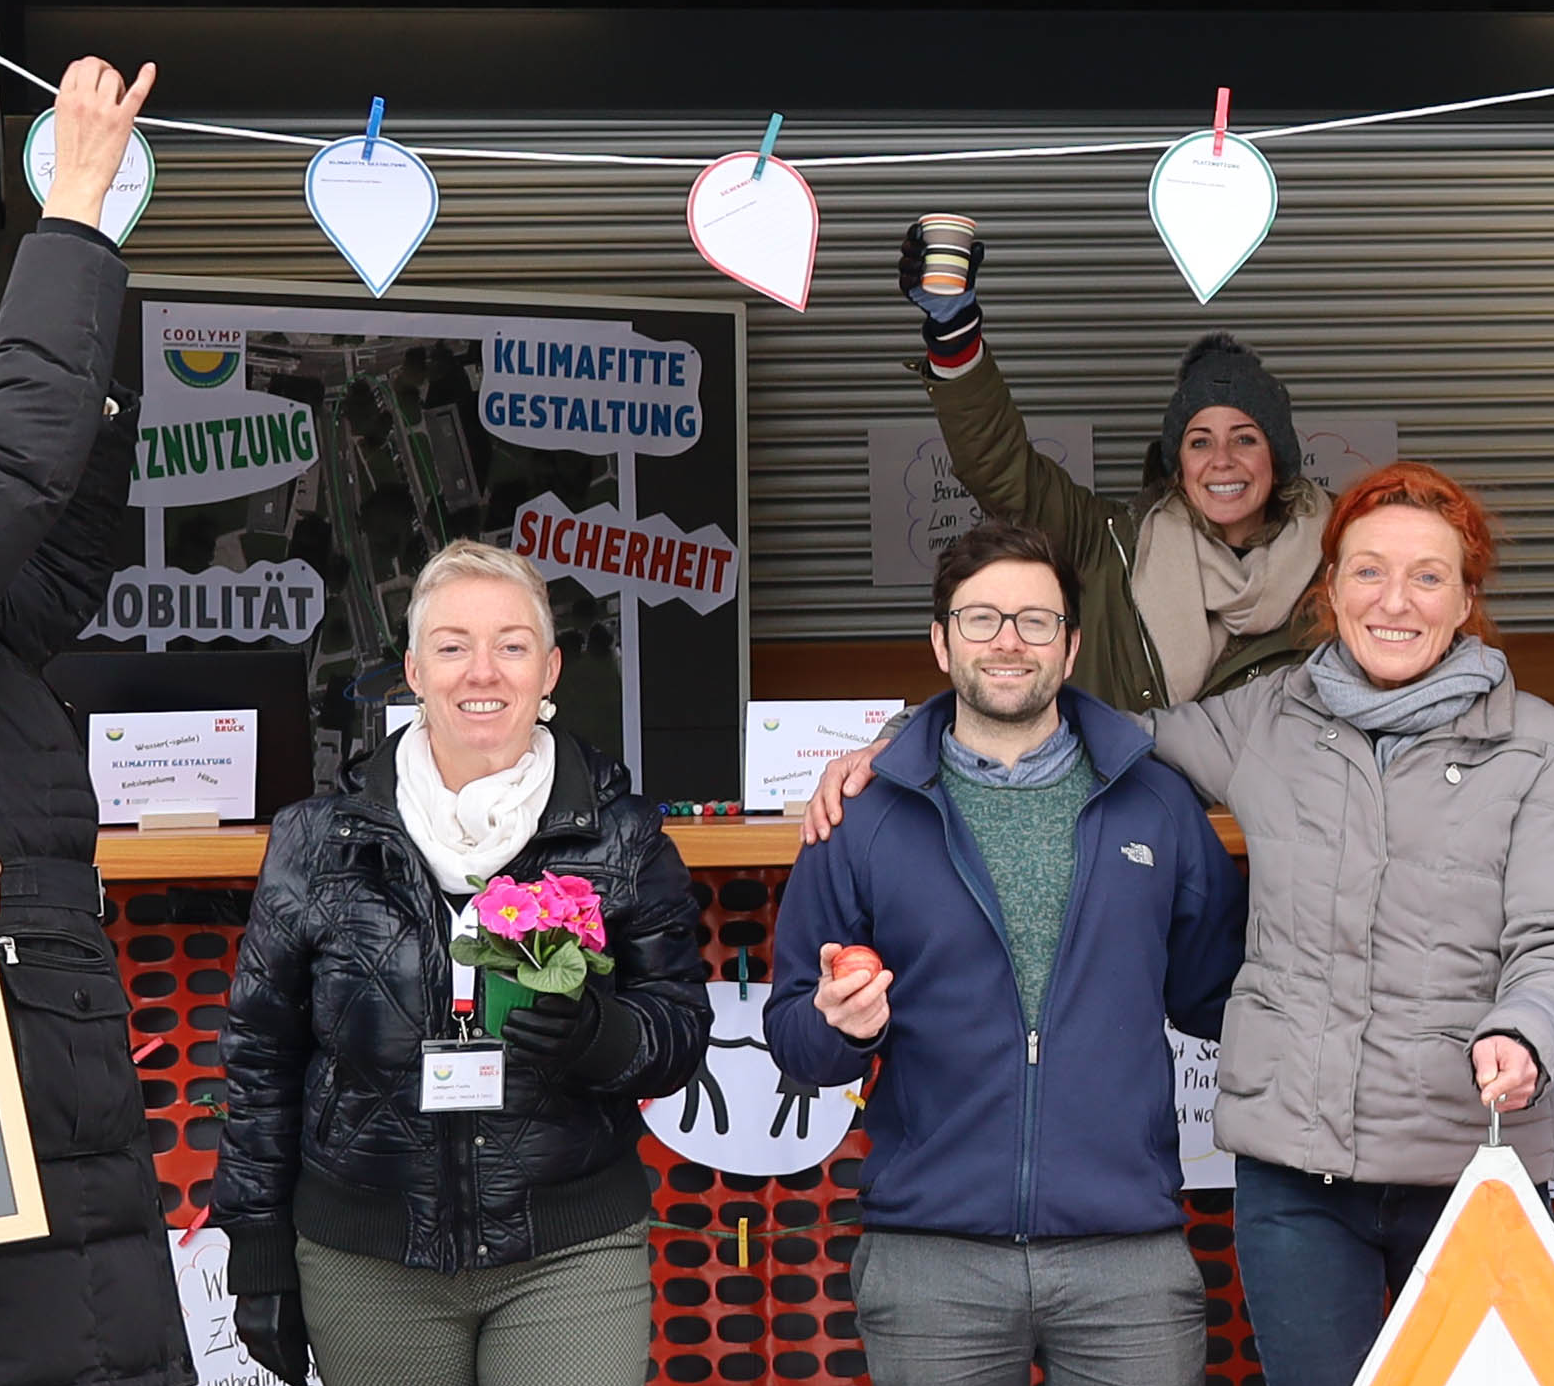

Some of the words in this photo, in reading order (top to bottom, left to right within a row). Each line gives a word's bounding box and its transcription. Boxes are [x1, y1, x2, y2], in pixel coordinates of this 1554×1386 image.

[163, 329, 241, 341] COOLYMP
[494, 336, 686, 387] KLIMAFITTE
[485, 391, 696, 438] GESTALTUNG
[133, 410, 314, 480] ZNUTZUNG
[517, 510, 732, 594] SICHERHEIT
[112, 759, 168, 768] KLIMAFITTE
[171, 758, 233, 767] GESTALTUNG
[1184, 1067, 1218, 1089] Plat
